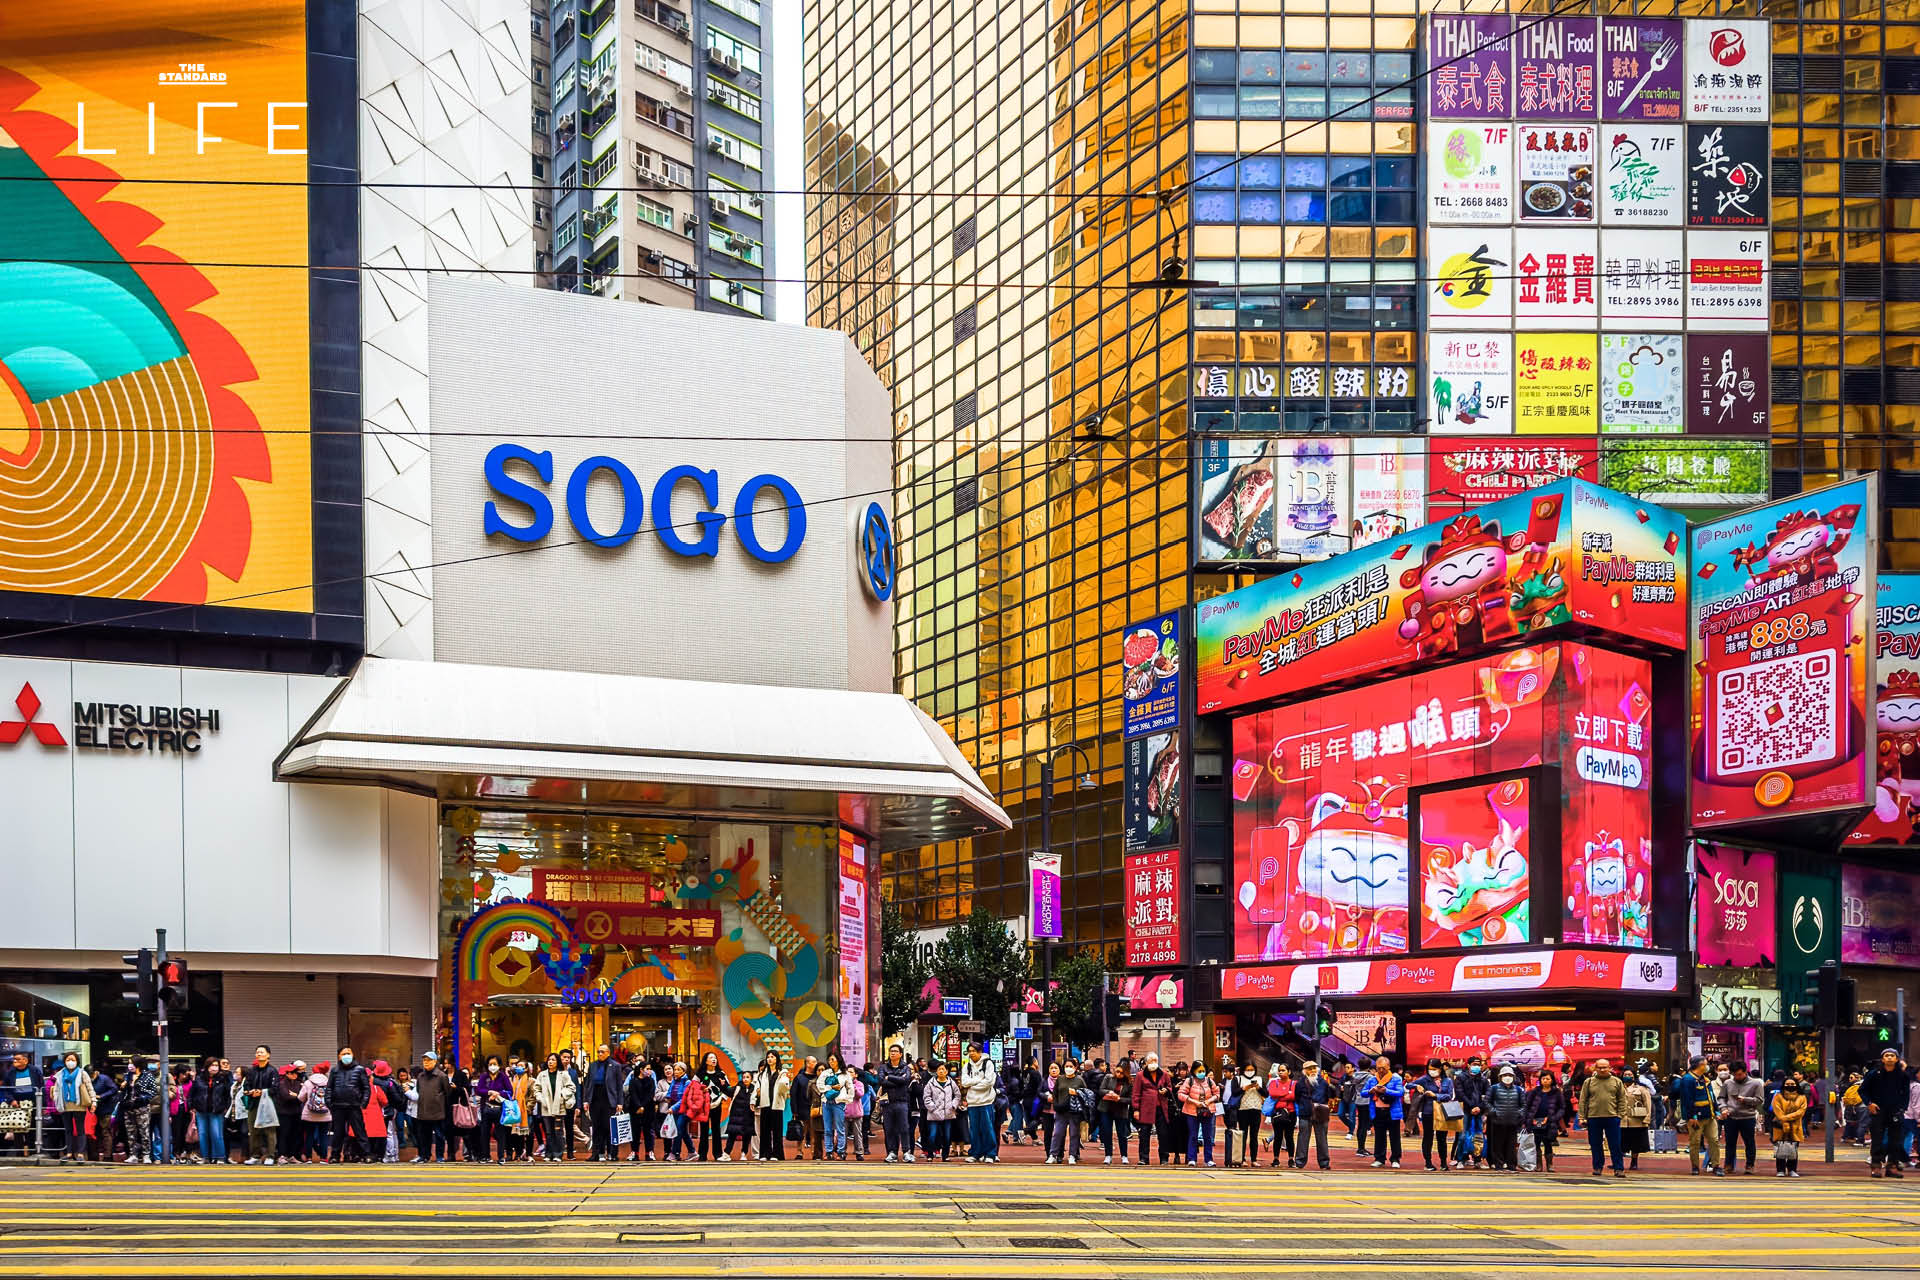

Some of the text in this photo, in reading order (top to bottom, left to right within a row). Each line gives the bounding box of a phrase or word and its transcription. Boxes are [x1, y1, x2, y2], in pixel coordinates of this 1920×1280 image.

[1434, 19, 1509, 57] THAI Perfect
[1519, 21, 1594, 59] THAI Food
[1605, 26, 1638, 52] THAI
[178, 63, 205, 72] THE
[1612, 56, 1640, 79] 泰式食
[158, 73, 227, 81] STANDARD
[1437, 61, 1506, 111] 泰式食
[1520, 62, 1593, 112] 泰式料理
[1607, 80, 1625, 97] 8/F
[1375, 105, 1415, 117] PERFECT
[1694, 103, 1709, 112] 8/F
[77, 102, 308, 154] LIFE
[1484, 128, 1509, 145] 7/F
[1651, 138, 1676, 151] 7/F
[1460, 197, 1483, 207] 2668
[1485, 197, 1508, 207] 8483
[1628, 208, 1669, 216] 36188230
[1740, 240, 1762, 253] 6/F
[1519, 253, 1594, 304] 金羅寶
[1606, 258, 1681, 290] 韓國料理
[1654, 297, 1680, 306] 3986
[1737, 298, 1762, 307] 6398
[1444, 340, 1501, 359] 新巴黎
[1574, 384, 1594, 397] 5/F
[1702, 356, 1711, 416] 台式料理
[1486, 395, 1509, 409] 5/F
[1522, 405, 1592, 417] 正宗重慶風味
[1752, 412, 1766, 424] 5F
[1207, 463, 1220, 472] 3F
[1465, 474, 1509, 488] CHILI
[483, 443, 807, 563] SOGO
[1584, 492, 1609, 510] PayMe
[1714, 523, 1753, 540] PayMe
[1582, 532, 1613, 553] 新年派
[1212, 600, 1240, 615] PayMe
[1699, 604, 1760, 640] PayMe
[1749, 642, 1799, 664] 開運利是
[1161, 681, 1176, 694] 6/F
[74, 701, 220, 731] MITSUBISHI
[75, 725, 202, 753] ELECTRIC
[1573, 711, 1643, 751] 立即下載
[1586, 754, 1630, 780] PayMe
[1126, 827, 1136, 838] 3F
[1155, 853, 1169, 864] 4/F
[546, 873, 579, 881] DRAGONS
[1134, 867, 1174, 897] 麻辣
[1045, 904, 1053, 934] KONG
[1134, 896, 1174, 926] 派對
[1842, 895, 1865, 927] iB
[1724, 909, 1748, 932] 莎莎
[1130, 950, 1176, 963] 2178 4898
[1401, 967, 1436, 979] PayMe
[1487, 965, 1534, 977] mannings
[1586, 960, 1609, 972] PayMe
[1640, 961, 1663, 982] KeeTa
[1247, 974, 1275, 985] PayMe
[561, 987, 618, 1005] SOGO
[1355, 1030, 1370, 1044] iB
[1431, 1033, 1606, 1048] 用PayMe 辦年貨
[1632, 1029, 1660, 1051] iB
